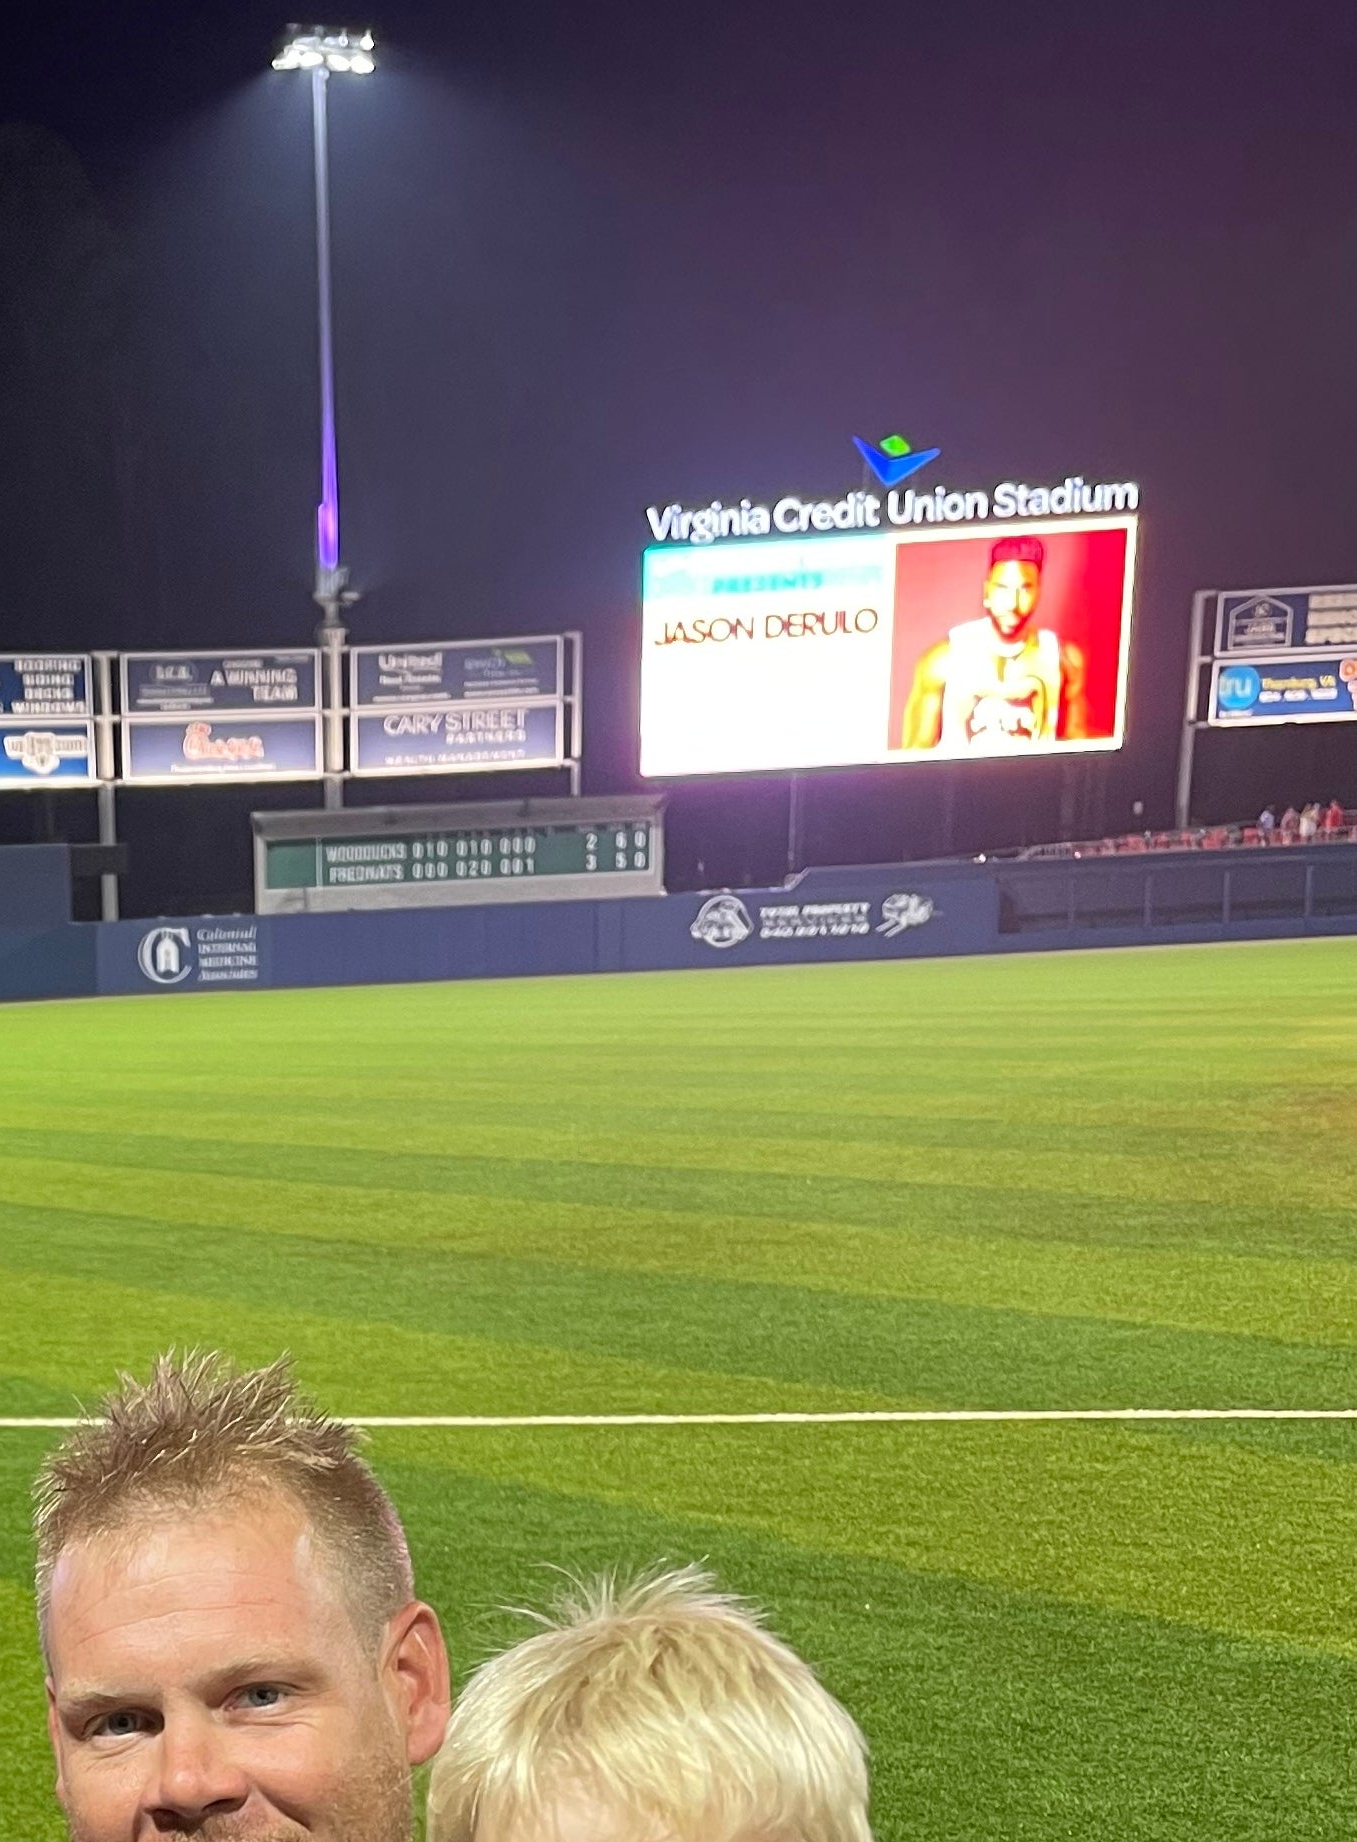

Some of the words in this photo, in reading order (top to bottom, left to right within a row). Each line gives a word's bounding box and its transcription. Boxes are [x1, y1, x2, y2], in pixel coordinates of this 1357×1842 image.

[645, 499, 771, 545] Virginia
[773, 491, 881, 532] Credit
[887, 486, 989, 525] Union
[992, 475, 1140, 519] Stadium
[712, 572, 825, 595] PRESENTS
[655, 616, 754, 646] JASON
[765, 608, 879, 639] DERULO
[383, 712, 443, 737] CARY
[445, 708, 529, 732] STREET
